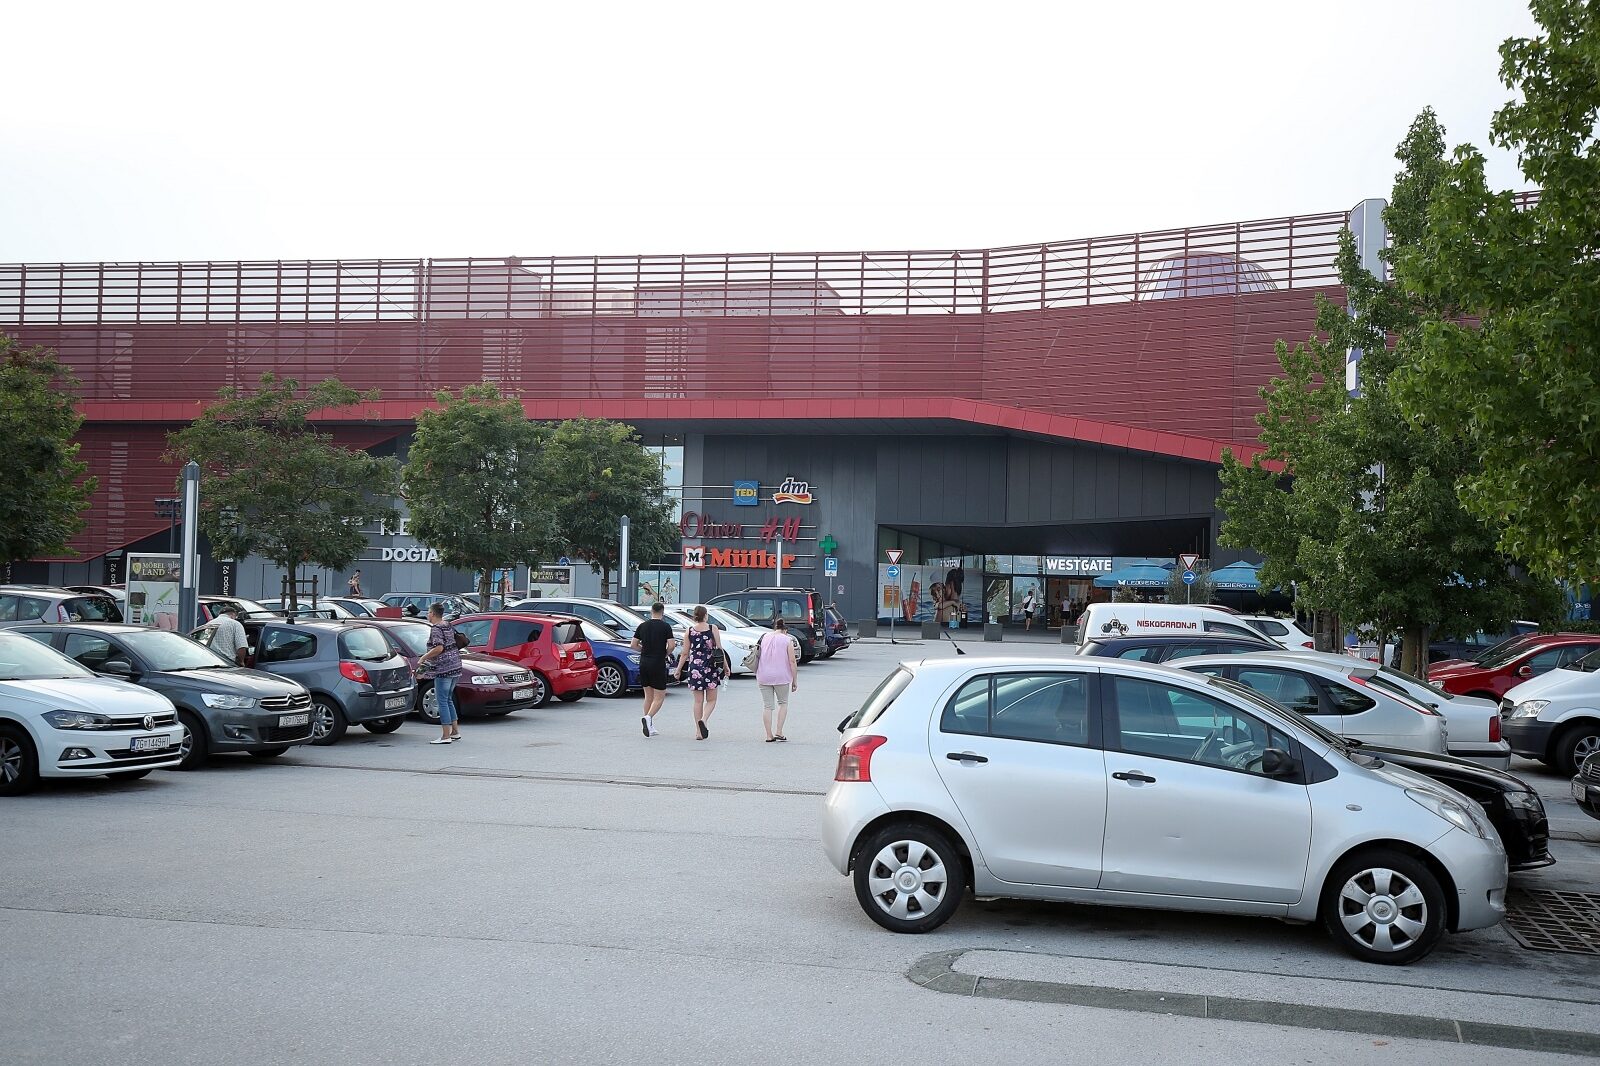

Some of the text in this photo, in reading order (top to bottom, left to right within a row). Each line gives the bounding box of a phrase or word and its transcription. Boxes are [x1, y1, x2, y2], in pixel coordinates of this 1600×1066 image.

[734, 488, 757, 497] TEDi
[781, 477, 808, 494] dm
[760, 515, 802, 544] HM
[382, 544, 440, 561] DOĞTA
[710, 548, 796, 569] Müller
[141, 568, 165, 576] LAND
[1046, 558, 1112, 571] WESTGATE
[1136, 620, 1197, 629] NISKOGRADNJA
